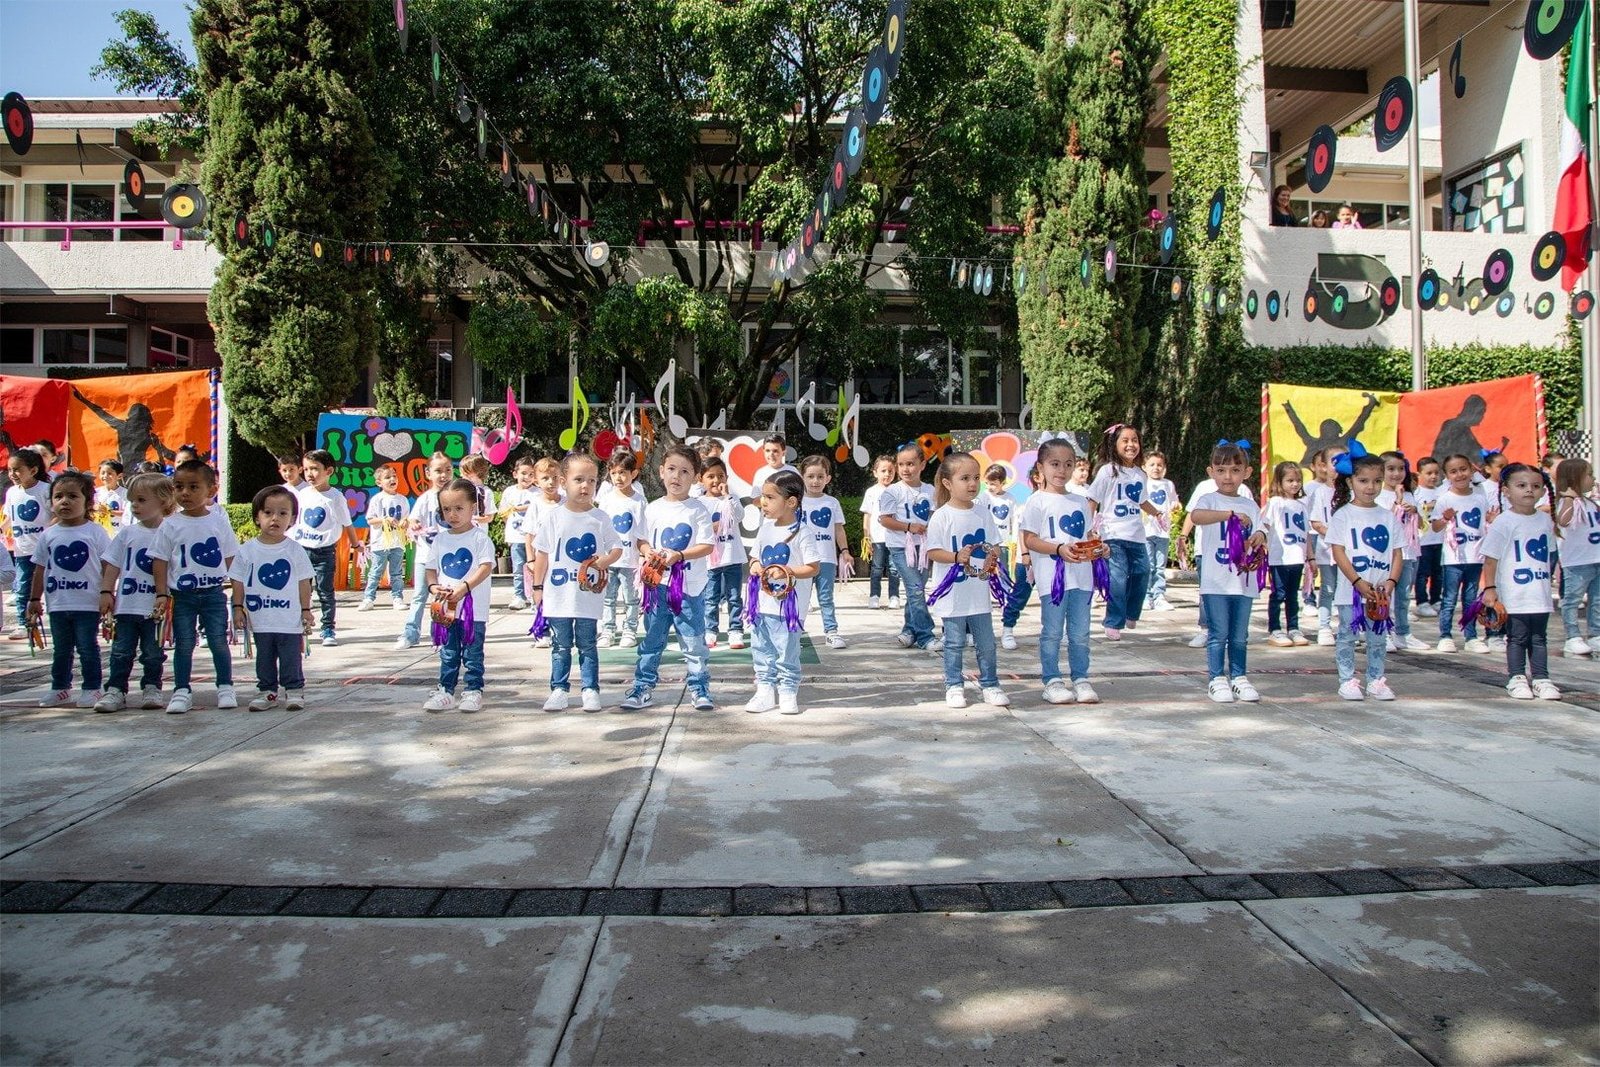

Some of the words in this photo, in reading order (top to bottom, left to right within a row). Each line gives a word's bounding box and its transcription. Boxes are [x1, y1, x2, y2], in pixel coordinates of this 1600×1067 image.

[328, 432, 341, 462] I
[1049, 516, 1056, 539] I
[1351, 528, 1358, 550] I
[126, 547, 132, 571] I
[180, 544, 187, 568] I
[1514, 540, 1521, 562] I
[247, 563, 253, 587] I
